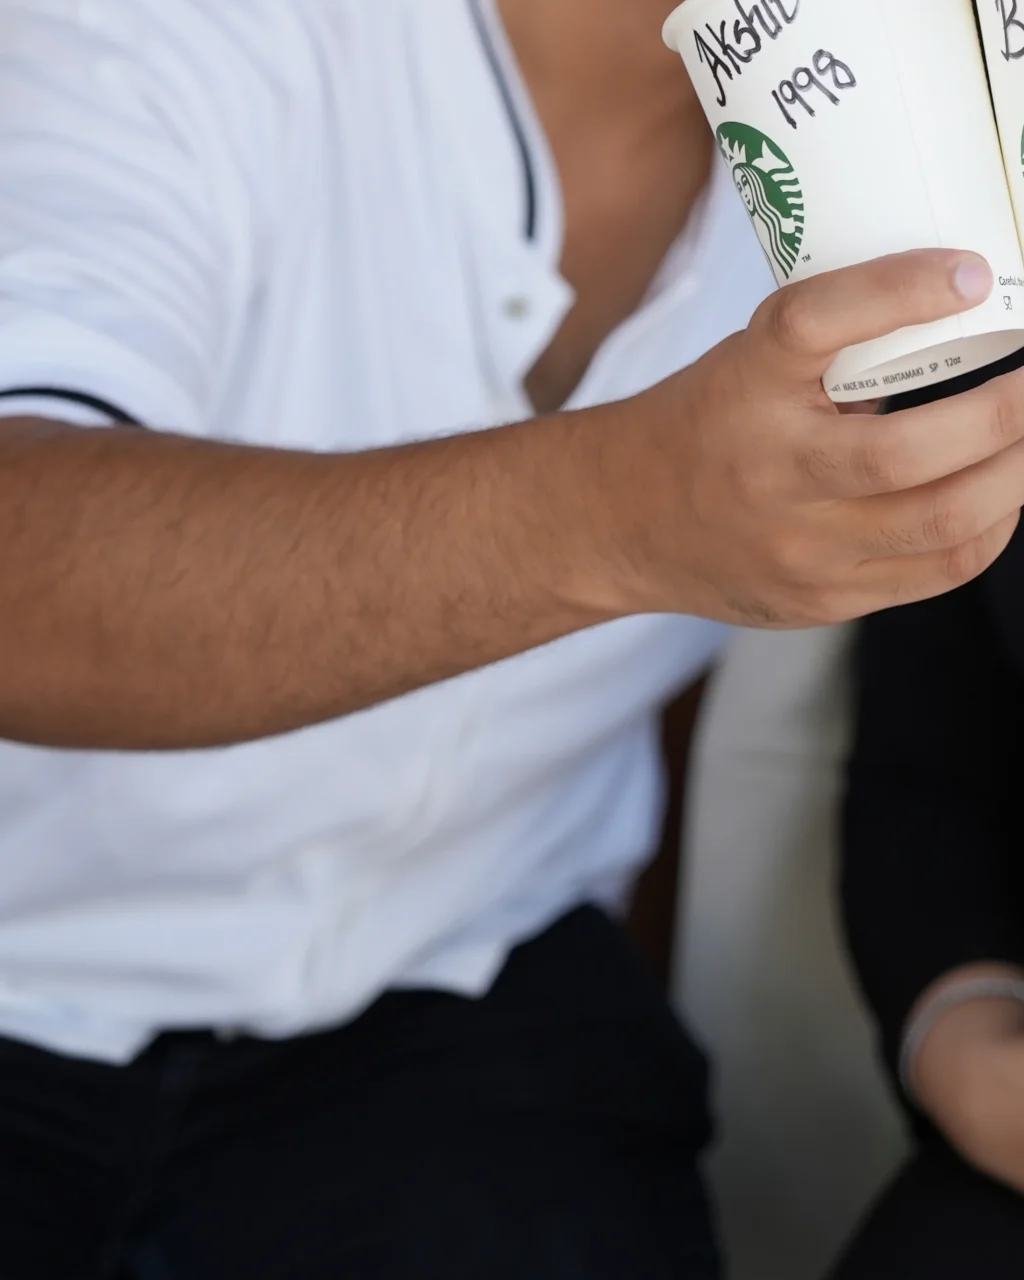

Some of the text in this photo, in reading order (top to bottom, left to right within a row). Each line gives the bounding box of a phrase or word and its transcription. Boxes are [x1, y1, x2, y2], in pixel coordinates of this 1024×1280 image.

[771, 48, 858, 130] 1998
[843, 381, 859, 391] MADE
[859, 380, 866, 389] IN
[865, 378, 879, 388] KSA
[928, 361, 939, 373] SP
[944, 356, 962, 368] 12oz
